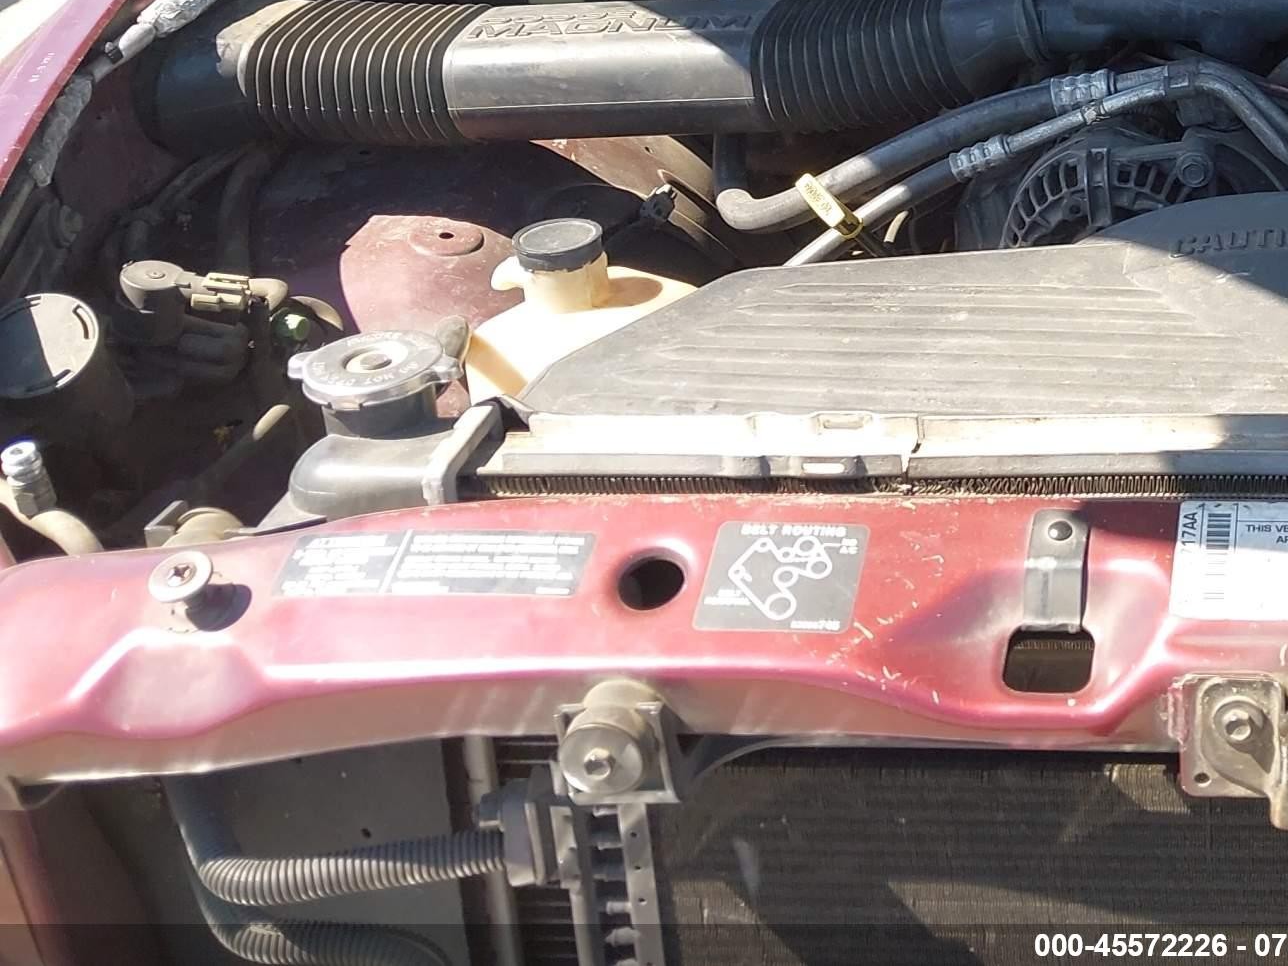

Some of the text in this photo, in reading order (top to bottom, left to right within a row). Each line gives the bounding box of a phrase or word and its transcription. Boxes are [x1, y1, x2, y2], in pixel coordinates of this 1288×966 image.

[466, 15, 752, 40] MAGNUM
[741, 522, 848, 538] BELT ROUTING
[1246, 524, 1272, 533] THIS
